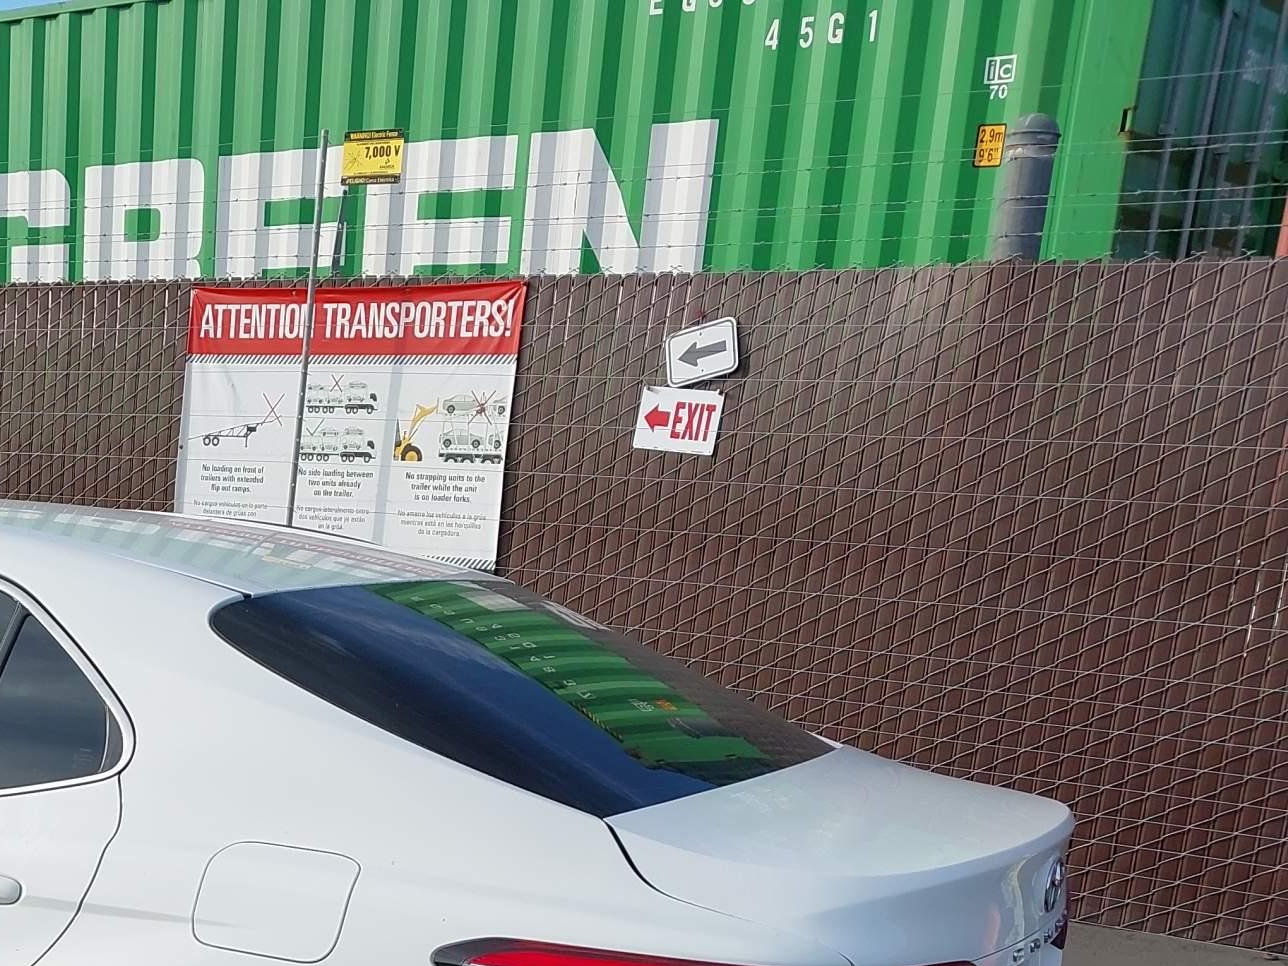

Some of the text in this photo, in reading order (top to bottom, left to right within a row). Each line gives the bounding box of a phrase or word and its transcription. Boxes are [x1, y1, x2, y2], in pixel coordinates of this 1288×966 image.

[989, 84, 1008, 100] 70
[365, 145, 400, 160] 7,000 V
[323, 298, 513, 339] TRANSPORTERS!
[669, 401, 717, 442] EXIT
[202, 464, 210, 472] No
[212, 464, 233, 474] loading
[299, 467, 373, 478] No side loading between
[406, 472, 414, 480] No
[416, 473, 447, 482] strapping
[338, 480, 361, 489] already
[452, 484, 462, 492] the
